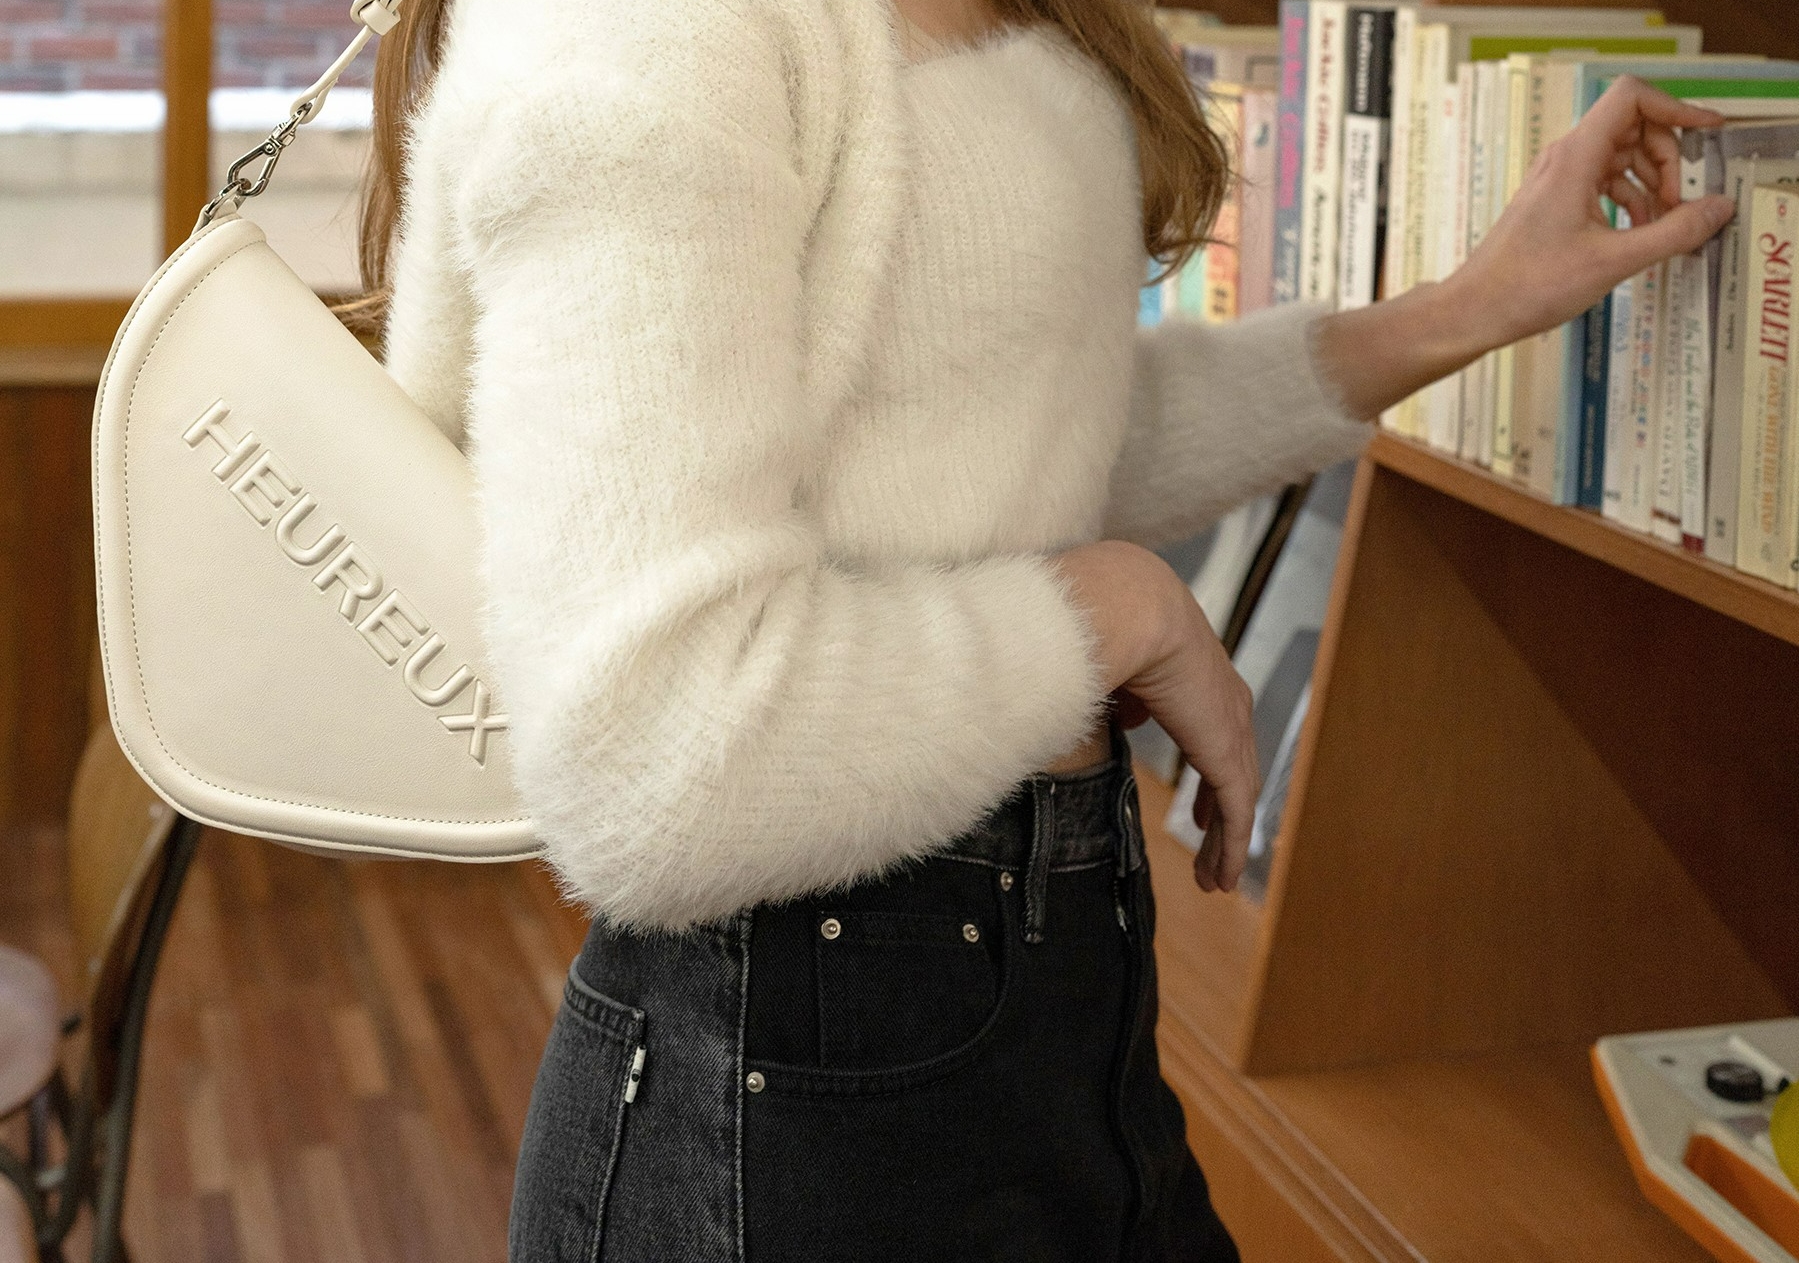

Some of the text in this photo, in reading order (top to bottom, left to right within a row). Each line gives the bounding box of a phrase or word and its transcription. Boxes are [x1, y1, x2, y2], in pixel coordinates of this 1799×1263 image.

[1757, 232, 1794, 367] SCARLETT
[1766, 365, 1783, 409] GONE
[1764, 413, 1781, 456] WITH
[1761, 490, 1779, 535] WIND
[182, 397, 511, 769] HEUREUX
